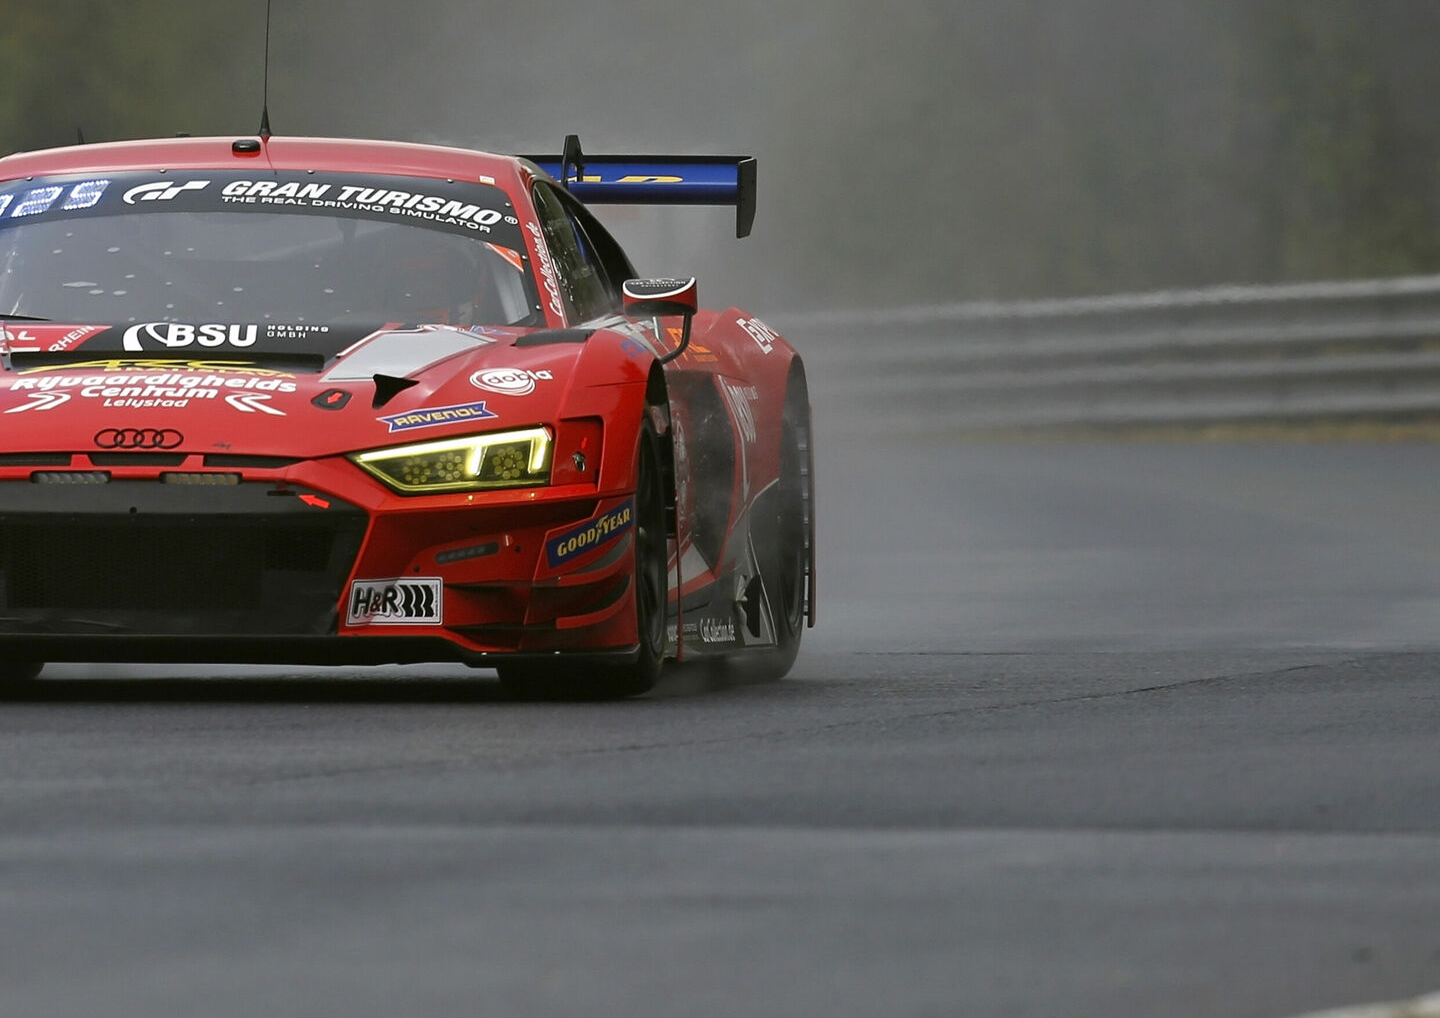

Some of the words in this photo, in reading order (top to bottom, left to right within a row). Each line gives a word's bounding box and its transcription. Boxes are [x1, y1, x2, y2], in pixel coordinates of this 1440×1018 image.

[221, 180, 331, 199] GRAN
[339, 185, 502, 226] TURISMO
[222, 196, 256, 204] THE
[261, 197, 308, 207] REAL
[311, 199, 385, 213] DRIVING
[389, 207, 492, 234] SIMULATOR
[165, 322, 258, 349] BSU
[267, 324, 329, 333] HOLDING
[487, 369, 553, 385] dobla
[80, 384, 218, 399] Centrum
[103, 397, 189, 409] Lelystad
[394, 407, 483, 427] RAVENOL
[557, 508, 631, 557] GOODYEAR
[352, 585, 403, 617] H&R
